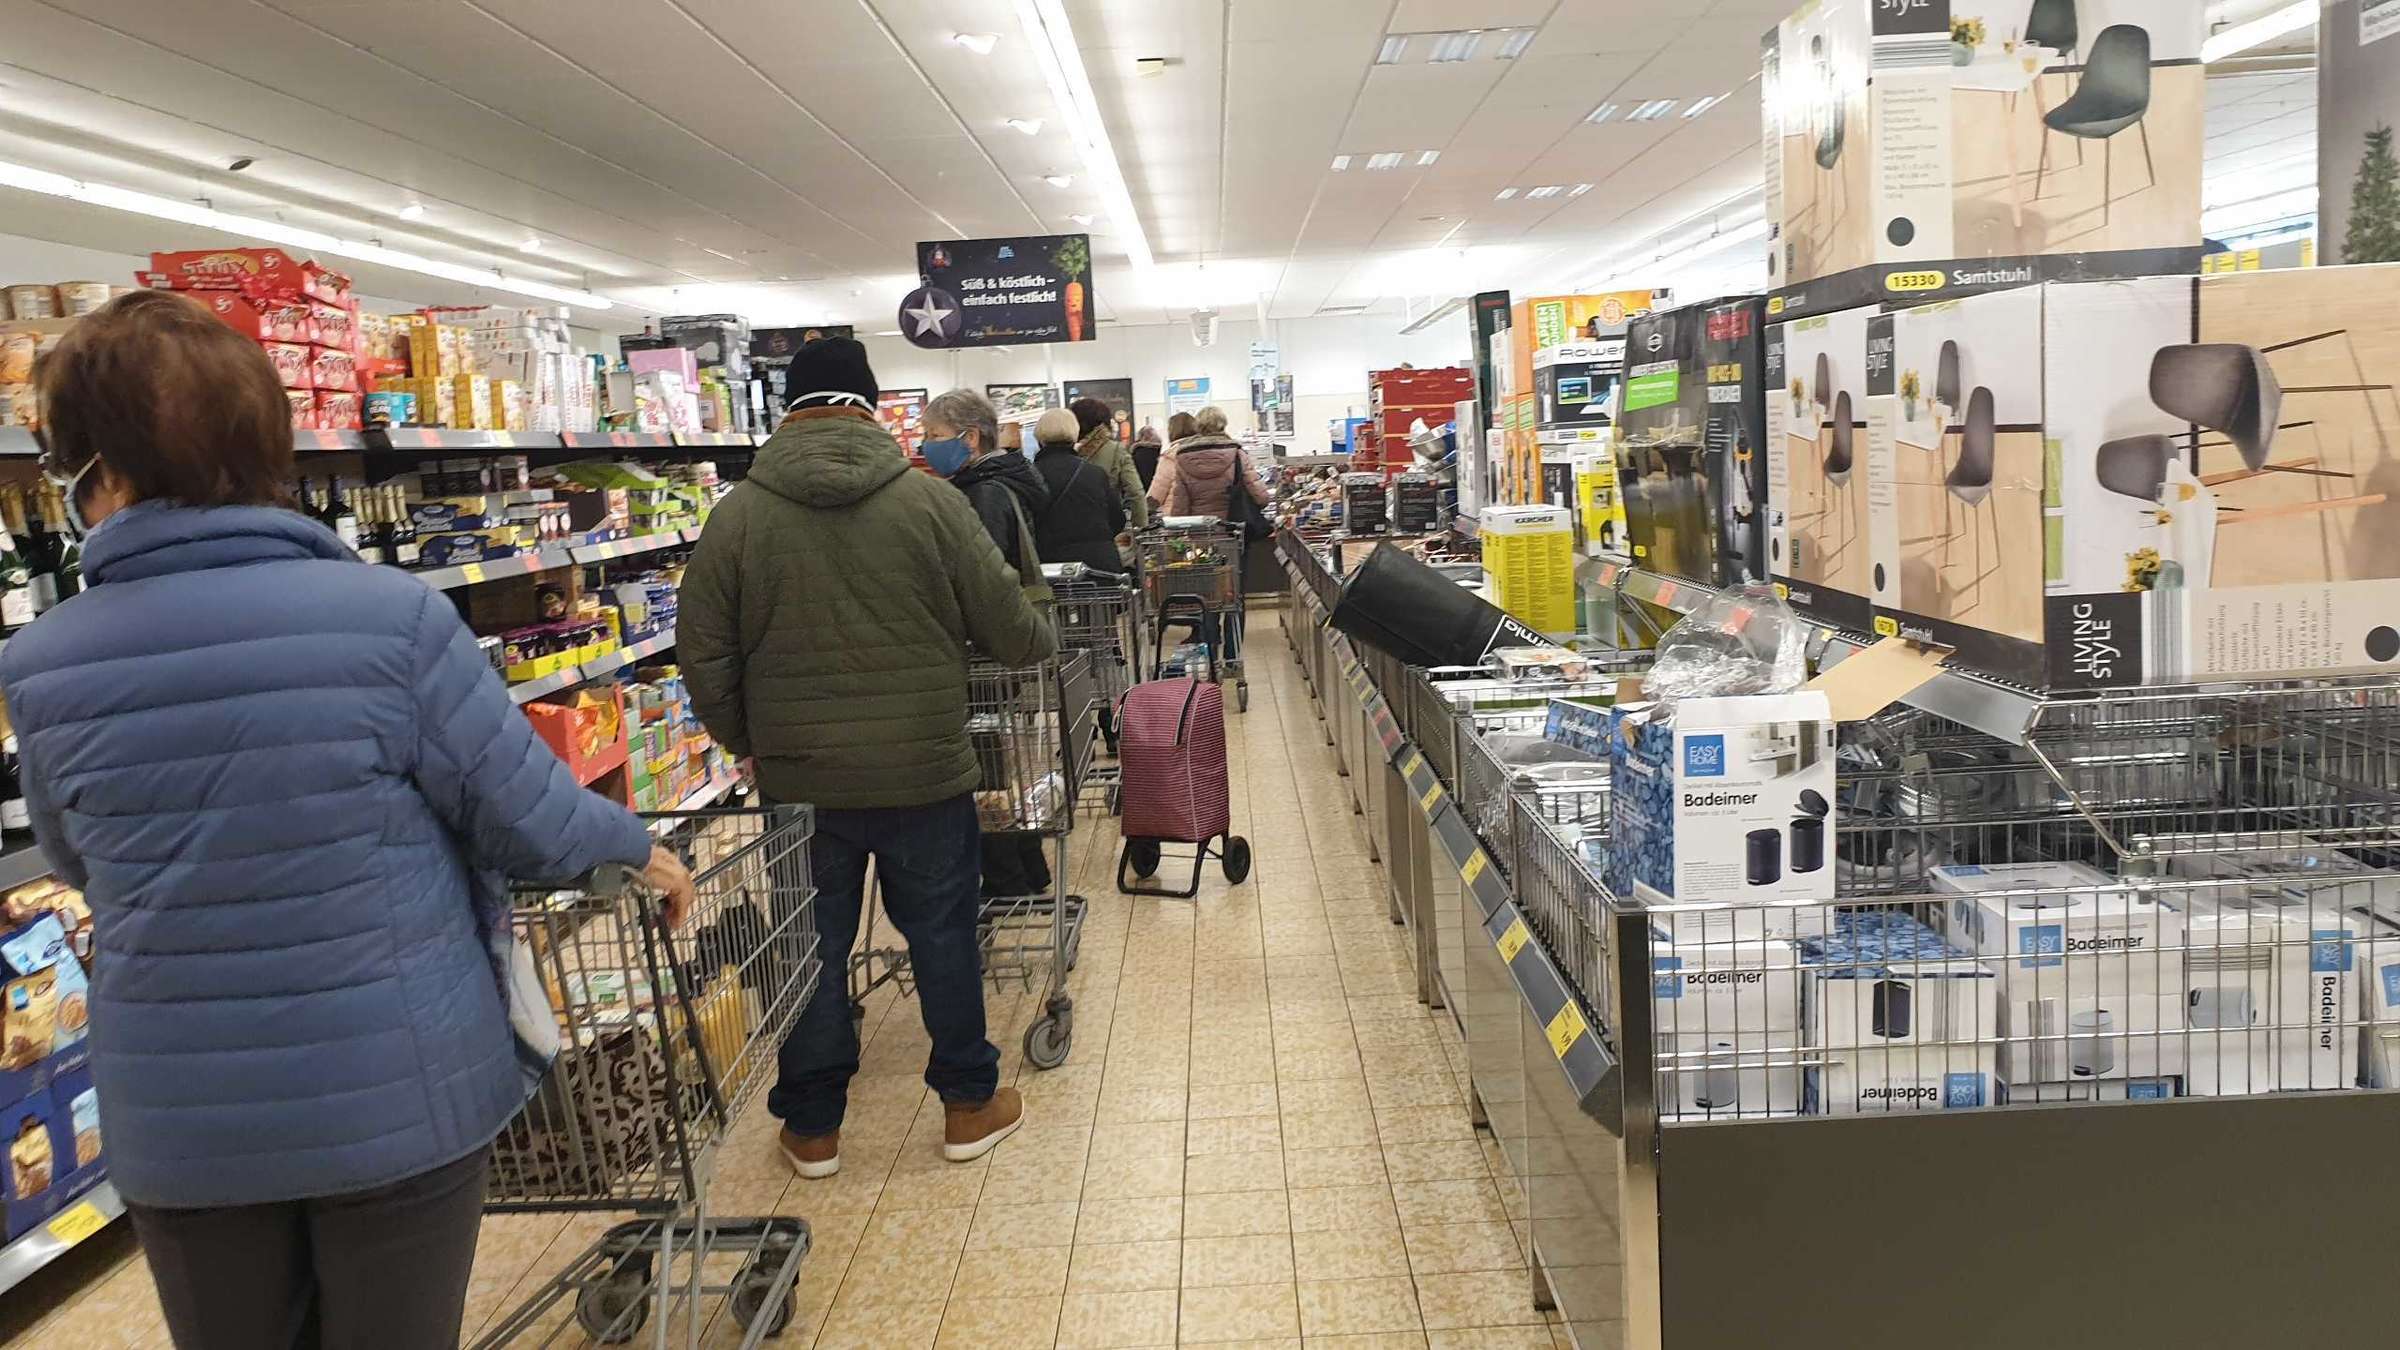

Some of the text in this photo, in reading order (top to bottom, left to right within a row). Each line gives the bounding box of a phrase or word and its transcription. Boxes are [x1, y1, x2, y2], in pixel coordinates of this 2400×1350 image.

[960, 278, 986, 290] Süß
[987, 278, 997, 289] &
[998, 275, 1046, 289] köstlich
[1893, 266, 2032, 287] 15330 Samtstuhl
[962, 291, 1057, 306] einfach festlich!
[2073, 603, 2093, 673] LIVING
[2092, 619, 2121, 678] STYLE
[1689, 745, 1722, 757] EASY
[1684, 792, 1758, 807] Badeimer
[2066, 936, 2144, 951] Badeimer
[1687, 971, 1762, 984] Badeimer
[1861, 1085, 1938, 1101] Badeimer
